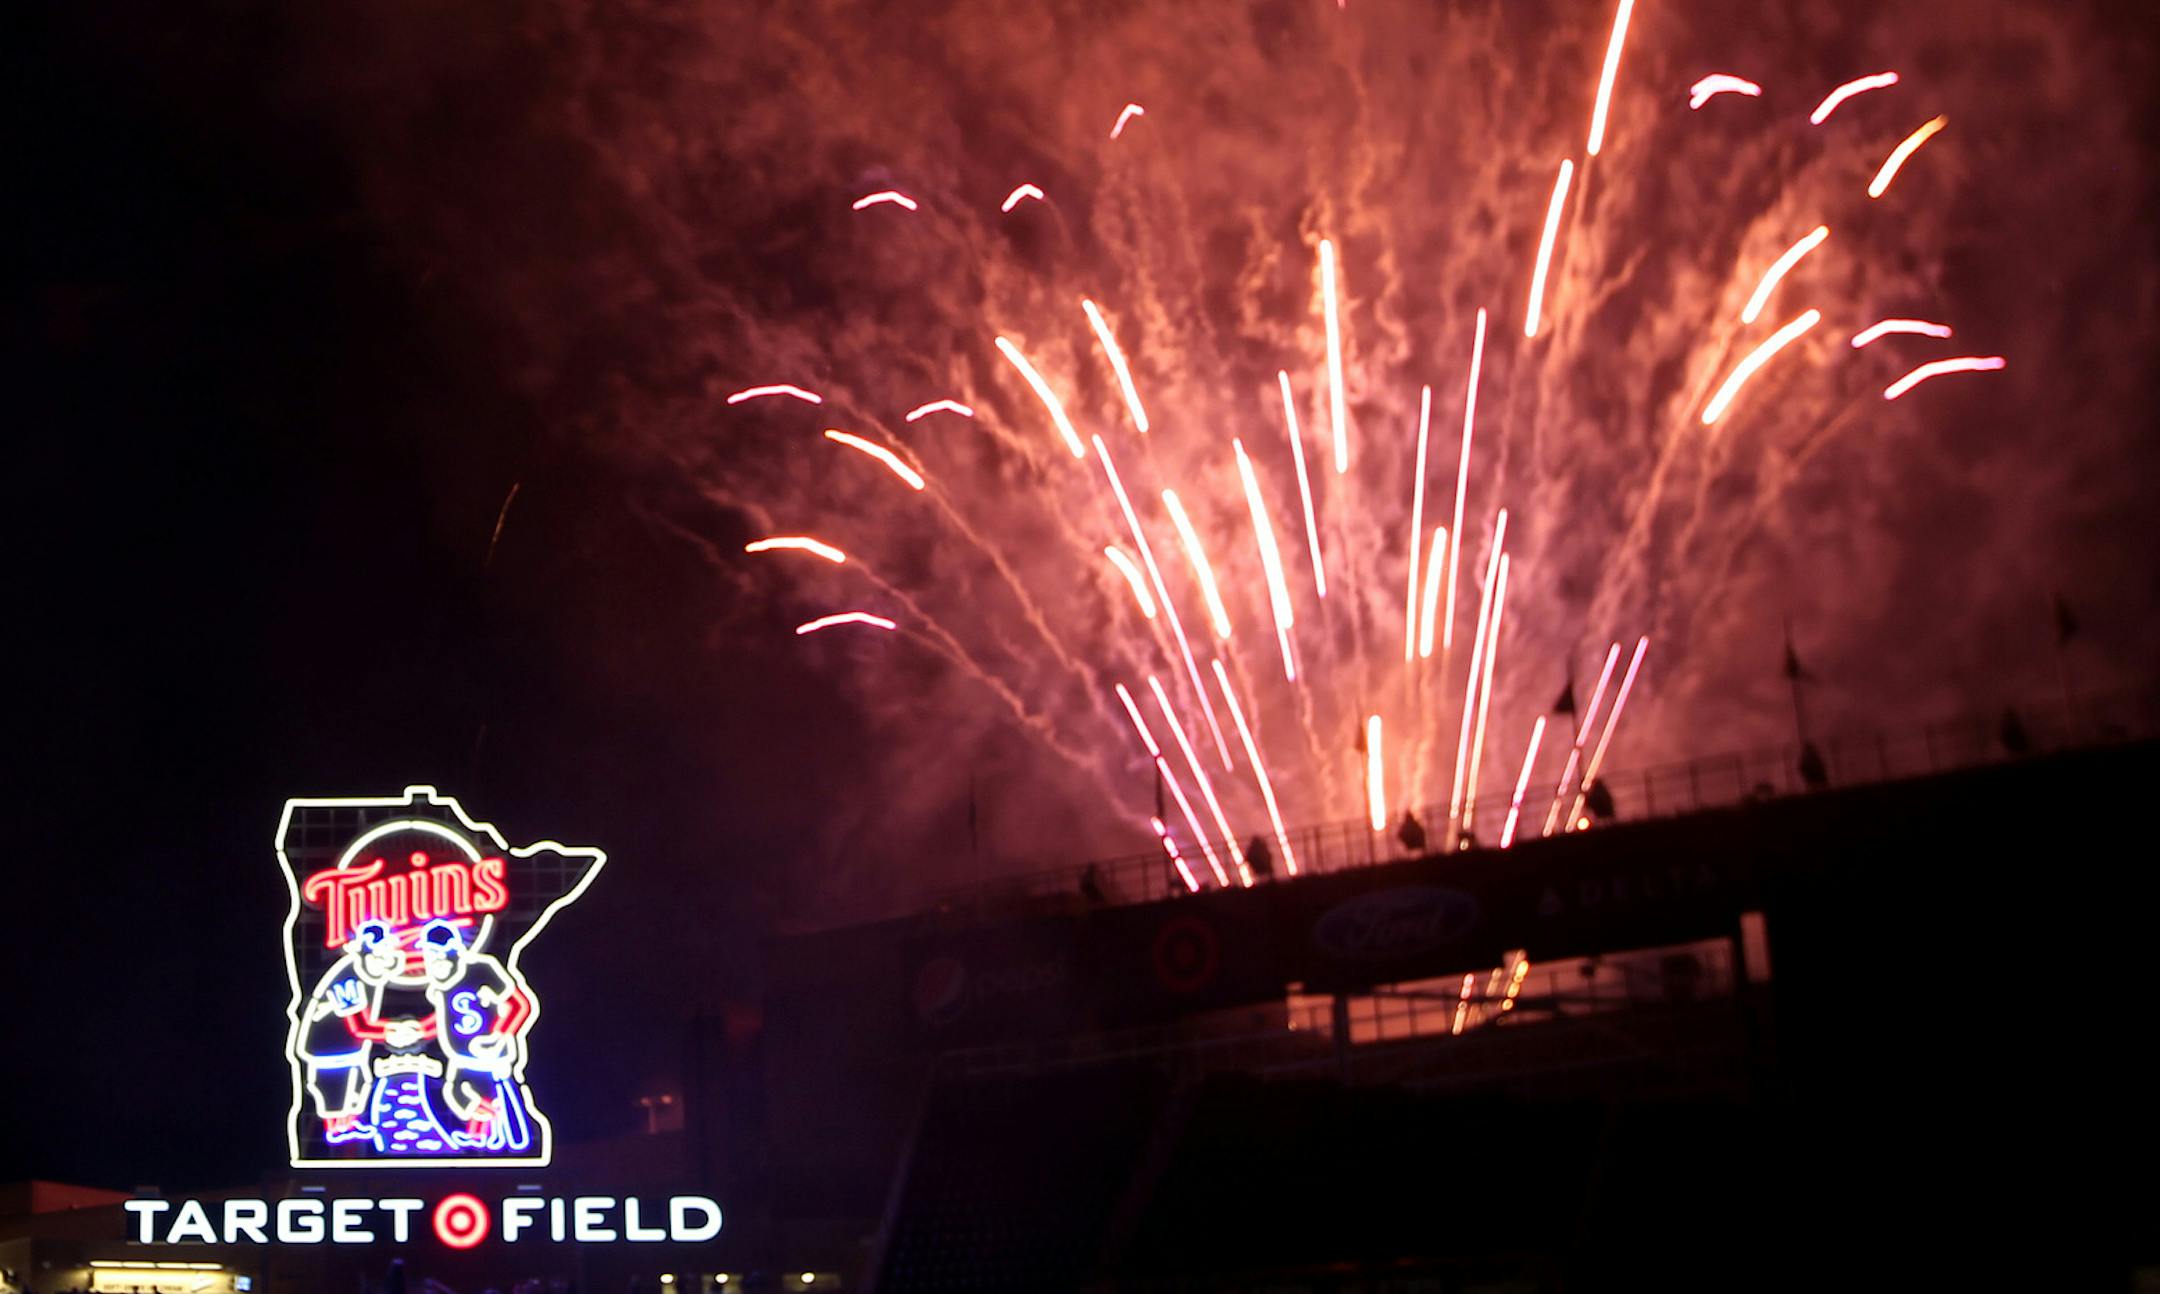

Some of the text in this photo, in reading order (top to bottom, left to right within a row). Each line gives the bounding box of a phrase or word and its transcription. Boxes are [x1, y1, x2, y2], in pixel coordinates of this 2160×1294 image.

[303, 852, 508, 947] Twins
[452, 991, 484, 1036] S
[124, 1197, 723, 1244] TARGET FIELD
